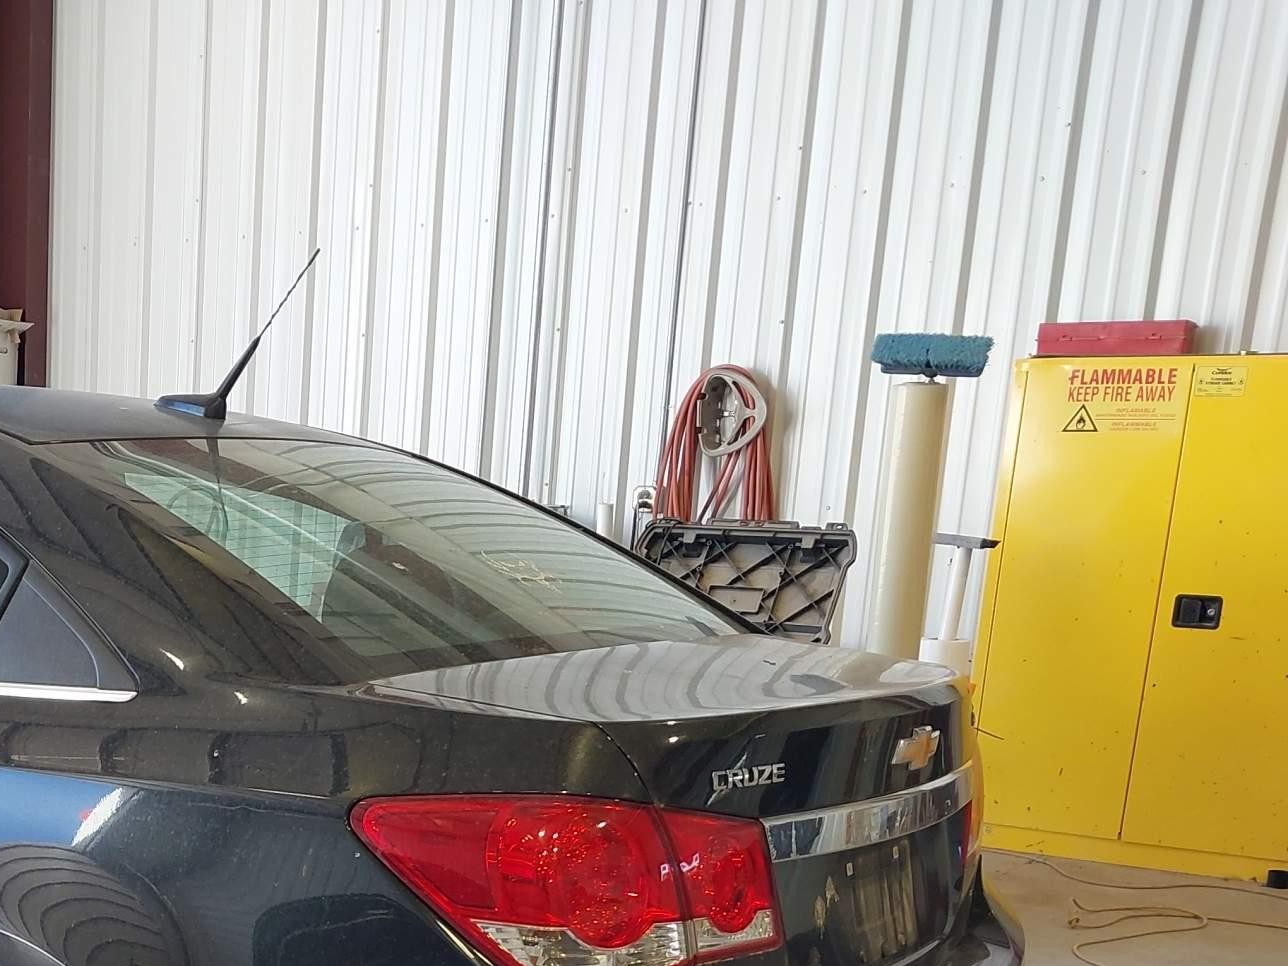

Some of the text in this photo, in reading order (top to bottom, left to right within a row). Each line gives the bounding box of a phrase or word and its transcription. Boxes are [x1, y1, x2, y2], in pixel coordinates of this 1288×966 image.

[1068, 368, 1178, 385] FLAMMABLE
[1067, 385, 1176, 402] KEEP FIRE AWAY
[711, 762, 786, 791] CRUZE
